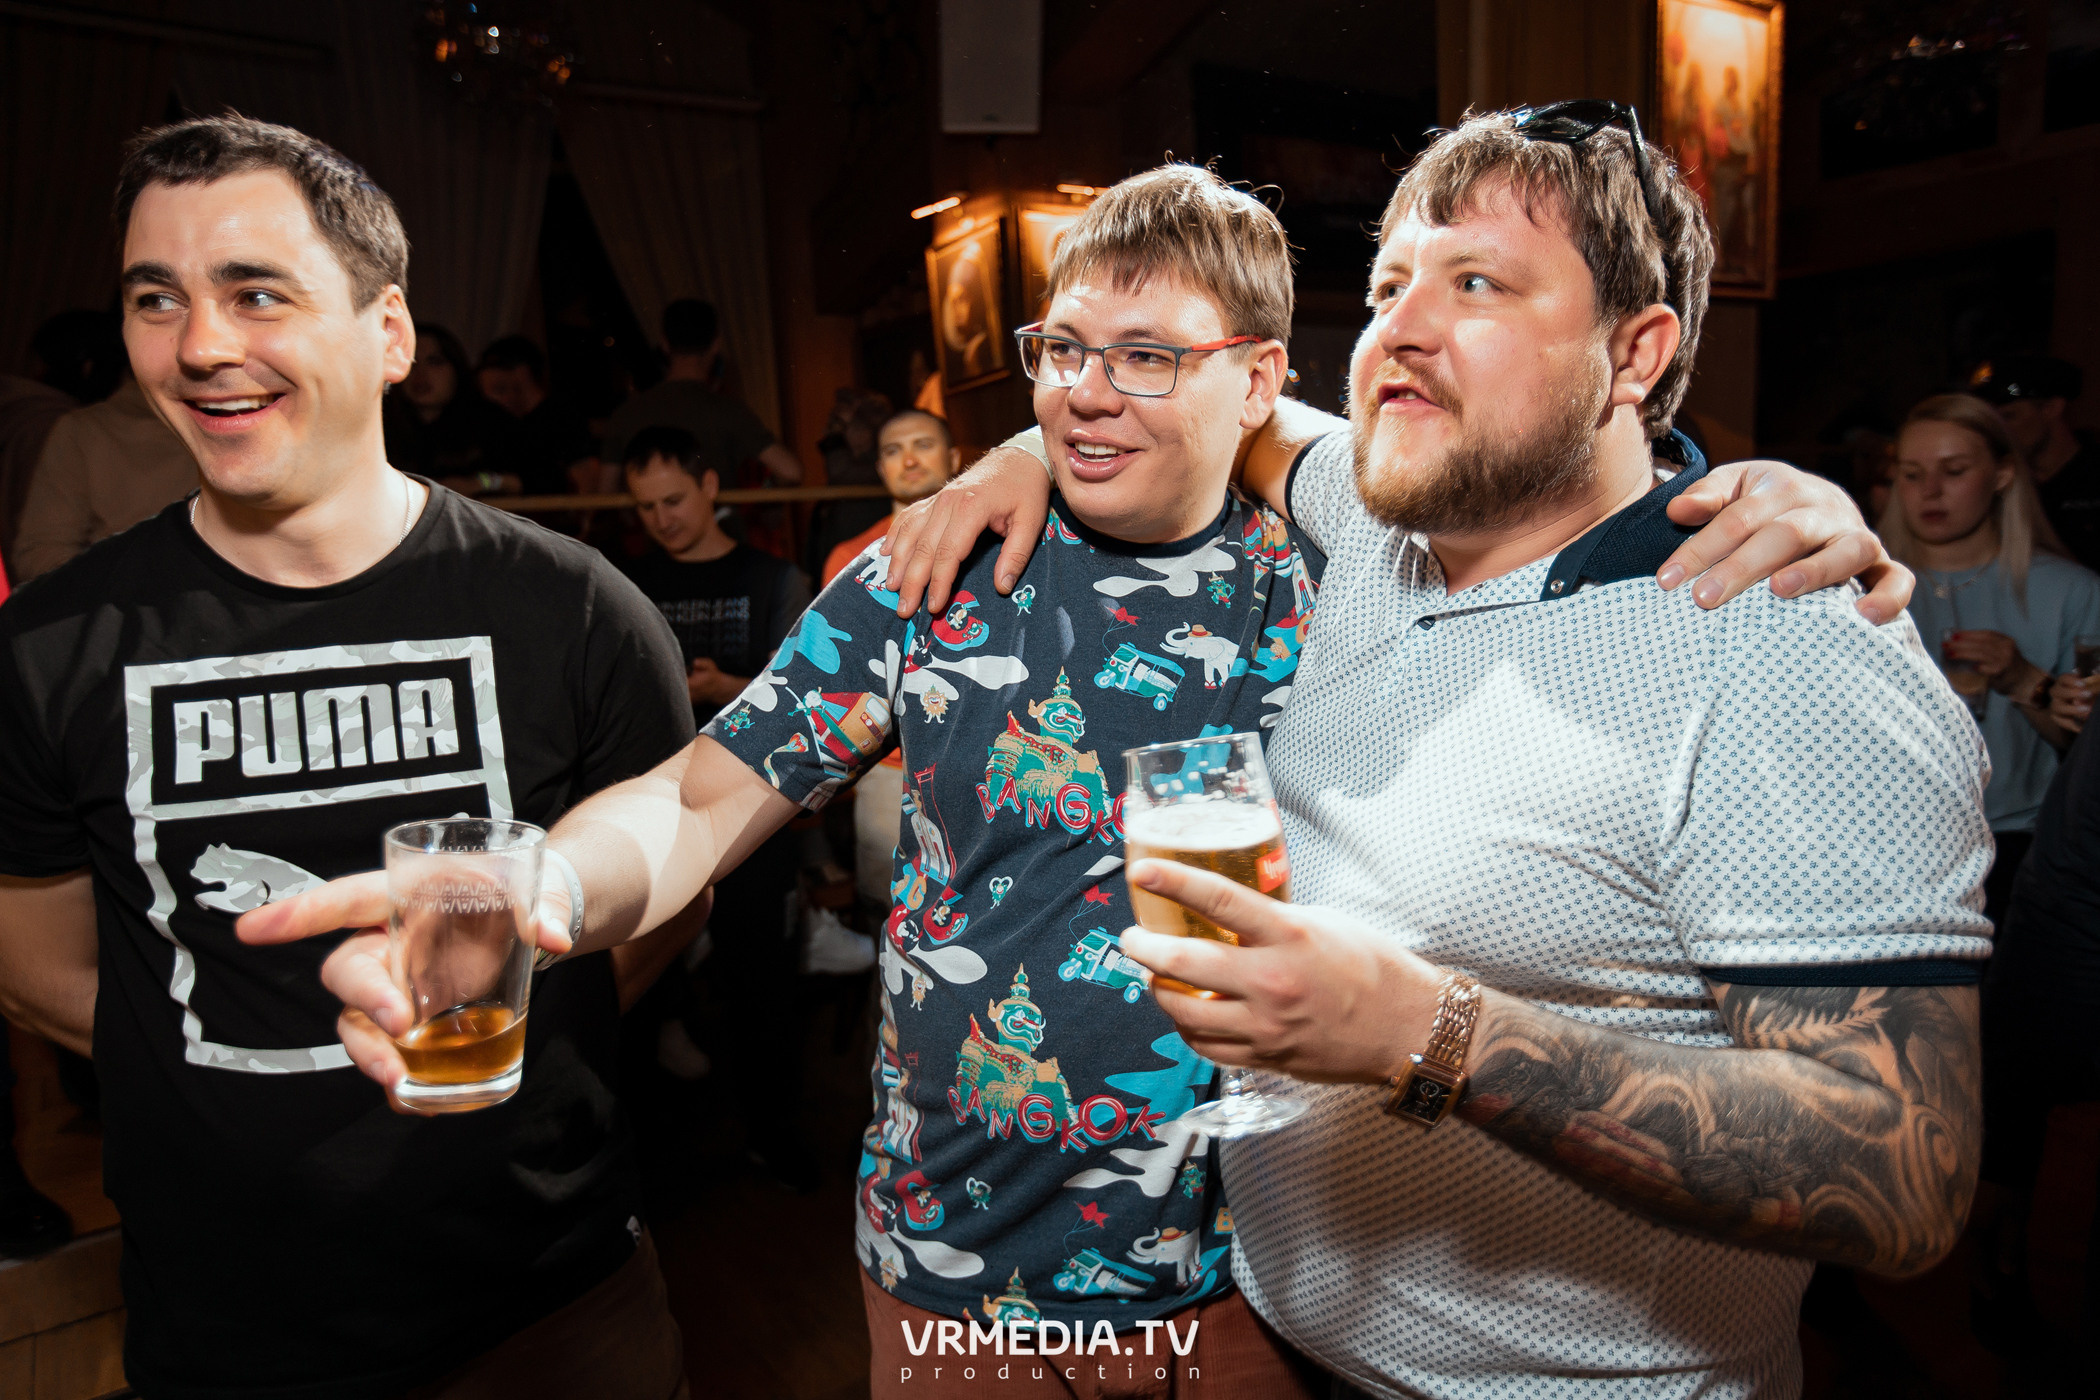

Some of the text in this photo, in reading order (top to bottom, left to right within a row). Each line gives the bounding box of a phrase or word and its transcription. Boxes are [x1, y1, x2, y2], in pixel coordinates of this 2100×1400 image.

[173, 677, 459, 785] PUMA
[975, 775, 1128, 846] BANGK
[947, 1085, 1166, 1152] BANGKOK
